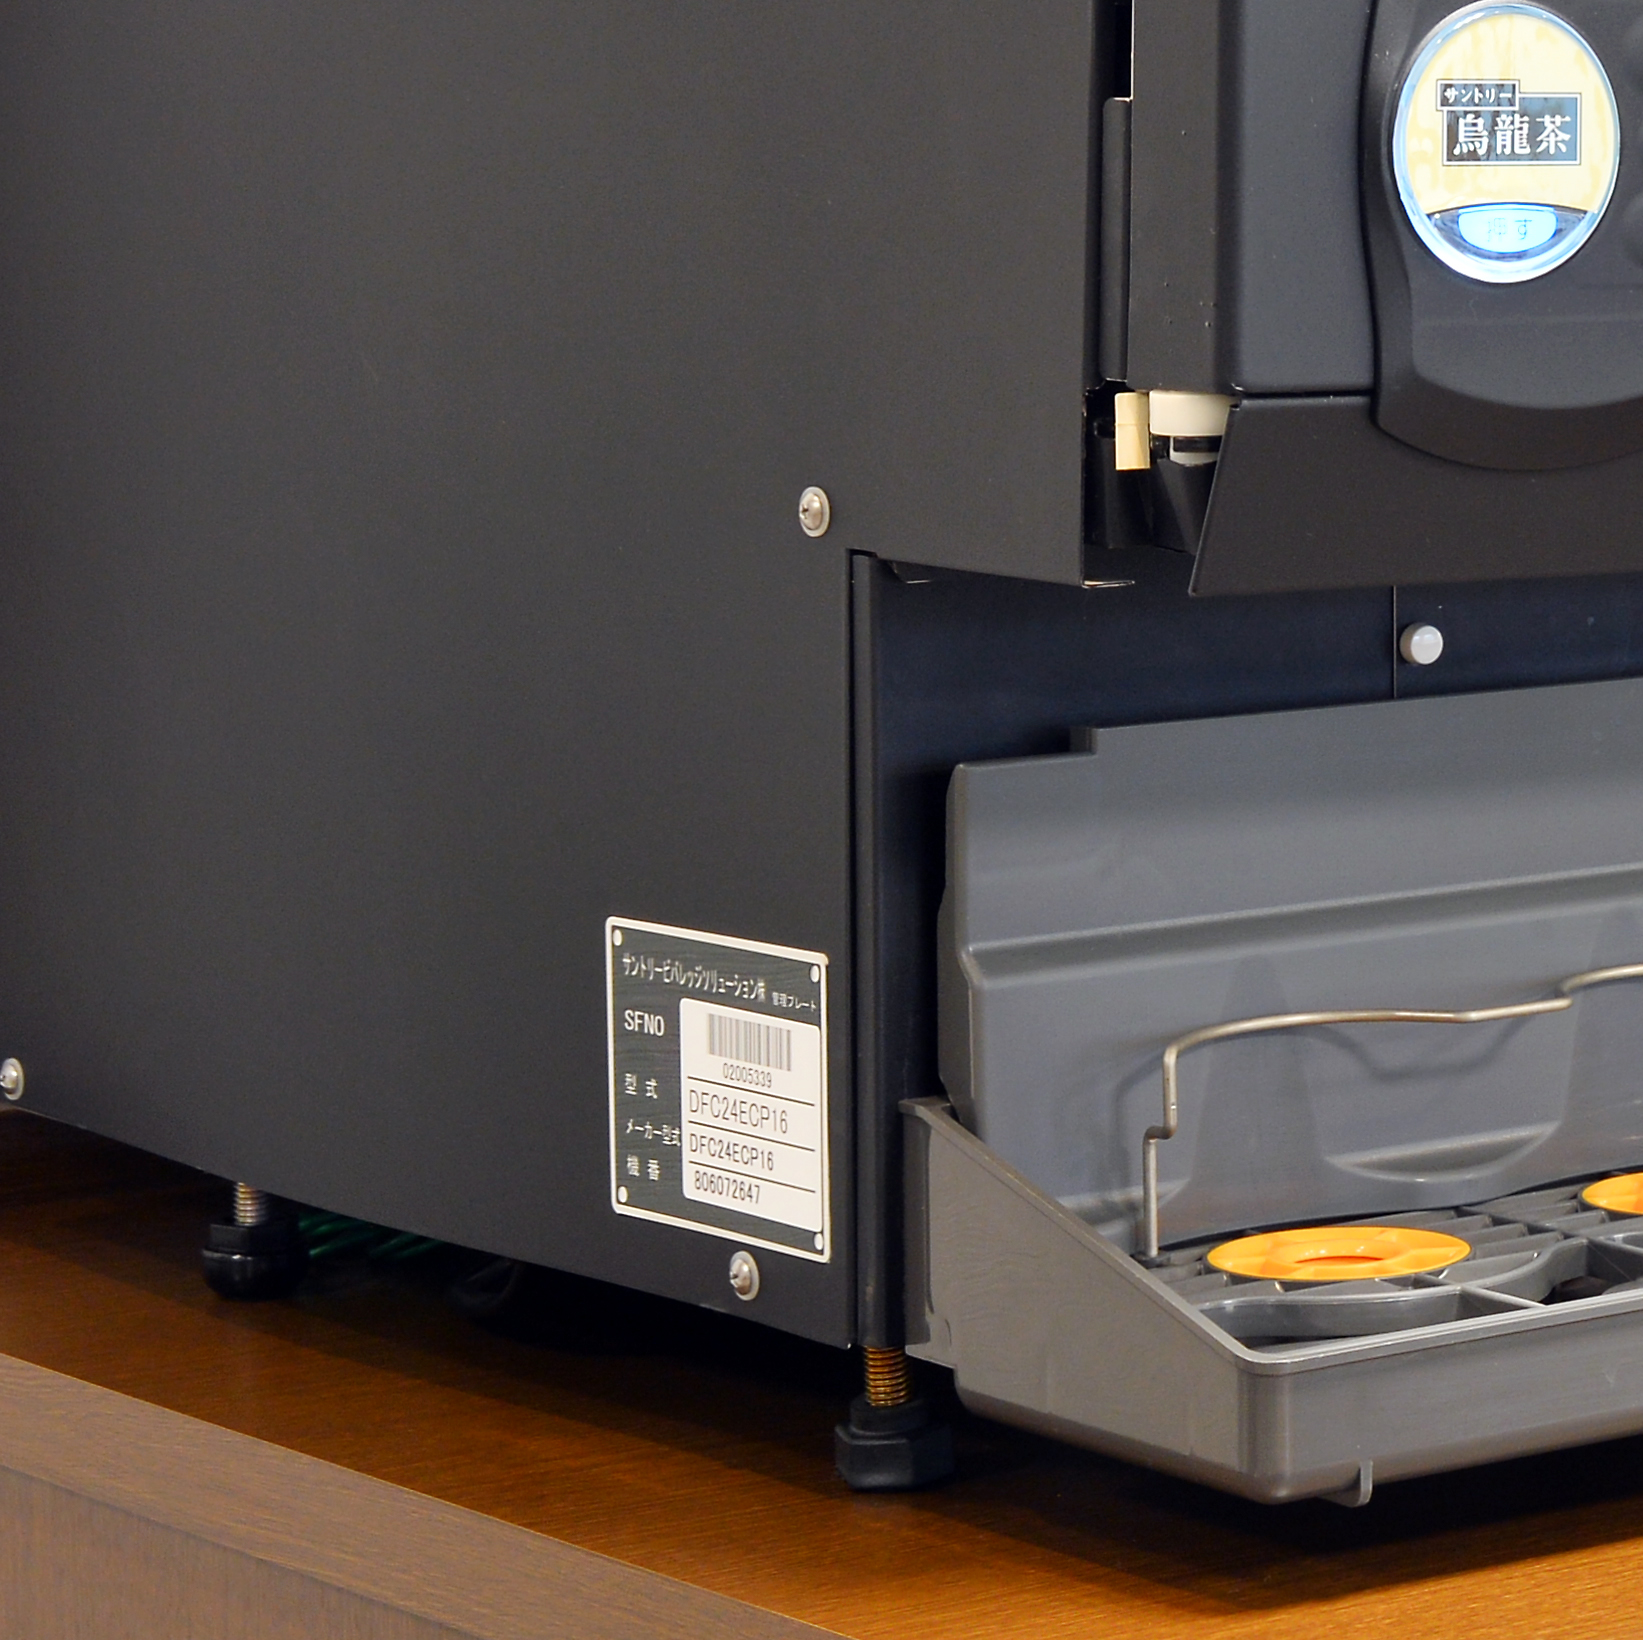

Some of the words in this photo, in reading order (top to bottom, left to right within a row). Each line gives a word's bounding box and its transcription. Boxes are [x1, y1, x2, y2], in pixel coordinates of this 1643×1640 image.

[1444, 87, 1512, 105] サントリー
[1453, 113, 1572, 156] 烏龍茶
[624, 1009, 665, 1037] SFNO
[722, 1062, 772, 1088] 02005339
[689, 1089, 788, 1134] DFC24ECP16
[689, 1132, 774, 1171] DFC24ECP16
[694, 1170, 760, 1204] 806072647
